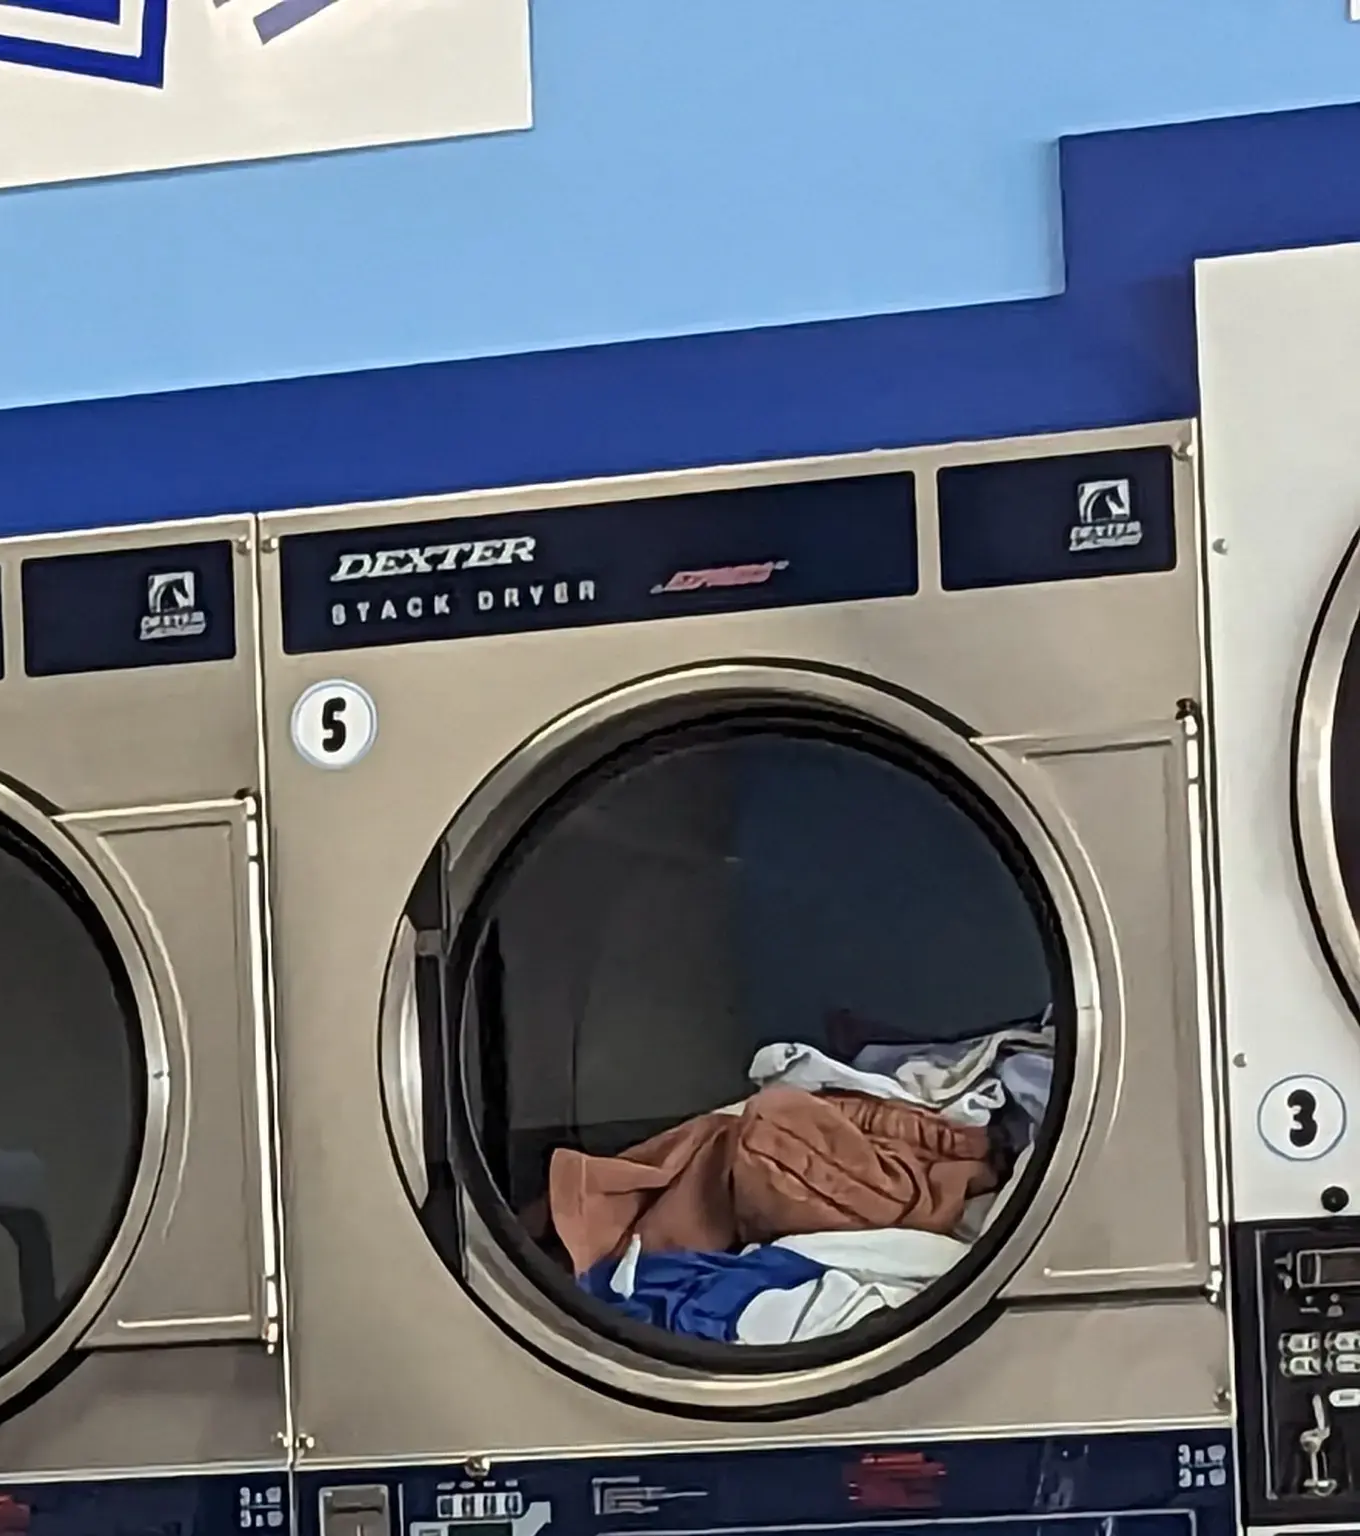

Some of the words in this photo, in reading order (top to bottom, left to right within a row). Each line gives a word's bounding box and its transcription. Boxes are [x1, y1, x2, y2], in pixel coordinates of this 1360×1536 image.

[330, 536, 536, 582] DEXTER
[332, 594, 451, 626] STACK
[478, 580, 596, 611] DRYER
[321, 697, 347, 752] 5
[1287, 1089, 1317, 1148] 3
